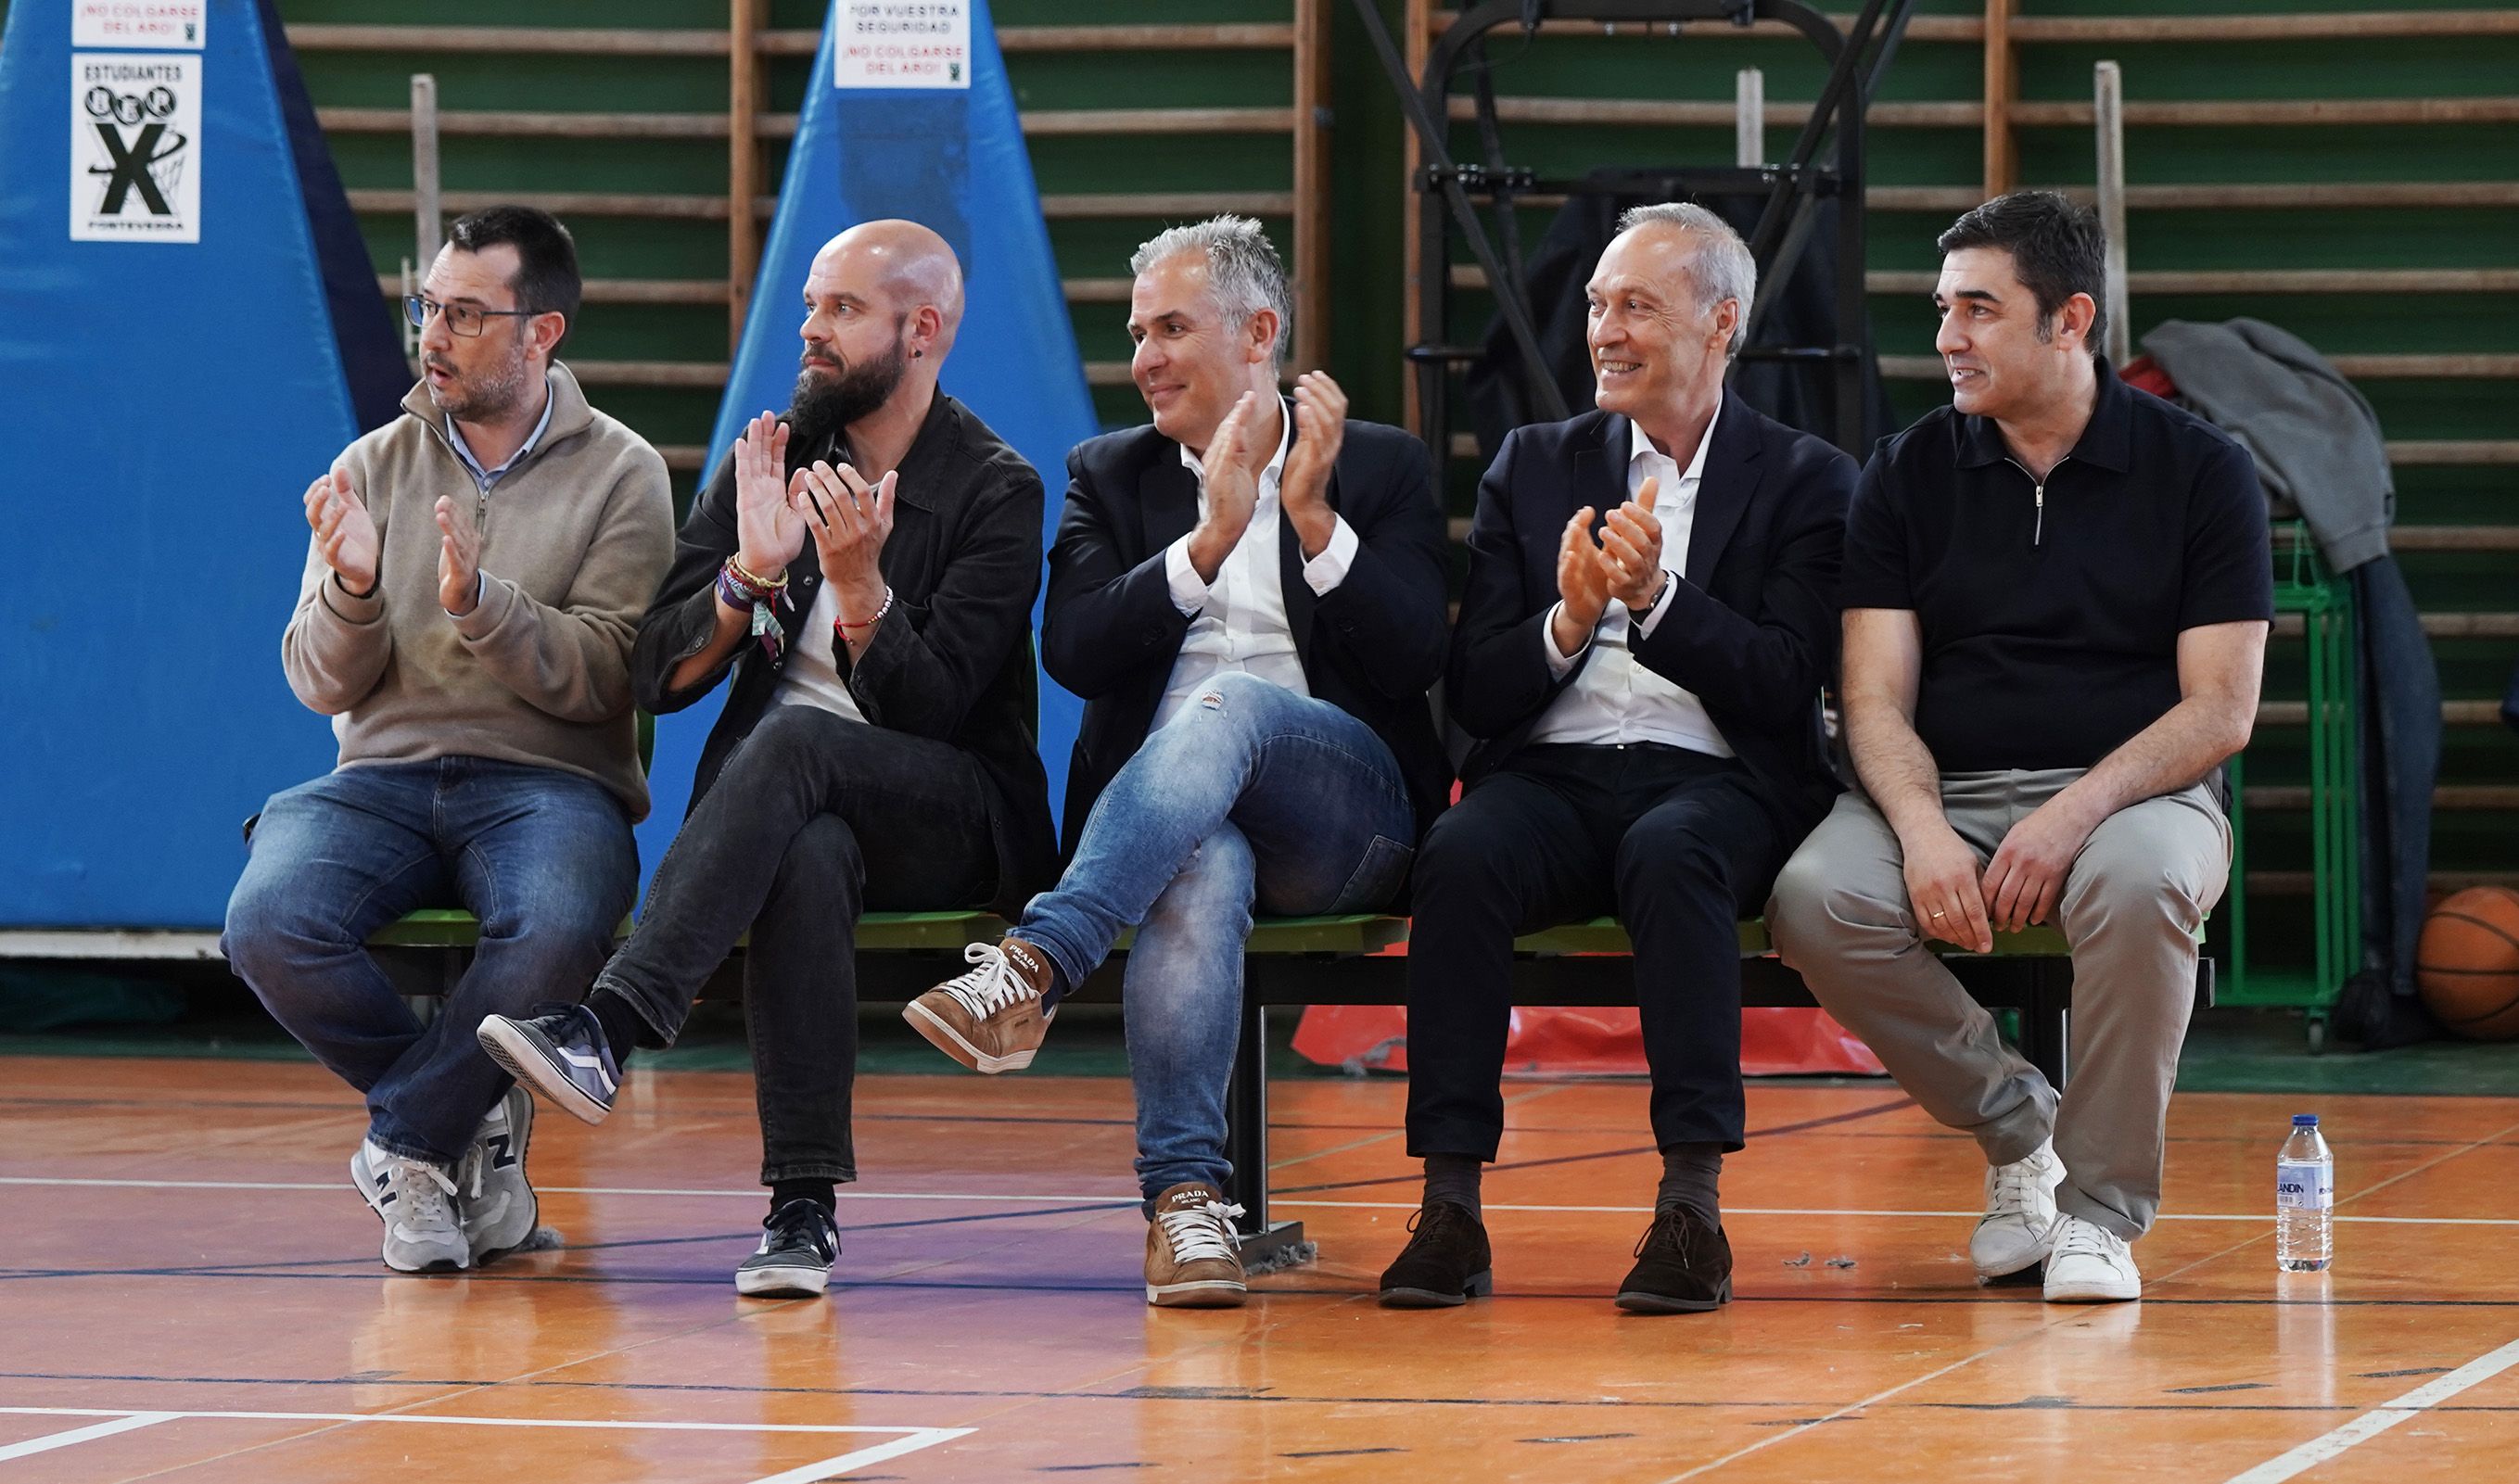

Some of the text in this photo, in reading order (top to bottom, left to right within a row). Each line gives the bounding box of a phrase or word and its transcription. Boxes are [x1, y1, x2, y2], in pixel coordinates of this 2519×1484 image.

[113, 6, 198, 17] COLGARSE
[884, 6, 959, 17] VUESTRA
[103, 23, 132, 33] DEL
[856, 22, 949, 33] SEGURIDAD
[875, 45, 961, 57] COLGARSE
[866, 61, 894, 73] DEL
[85, 65, 182, 82] ESTUDIANTES
[1009, 945, 1039, 973] PRADA
[1171, 1190, 1209, 1202] PRADA
